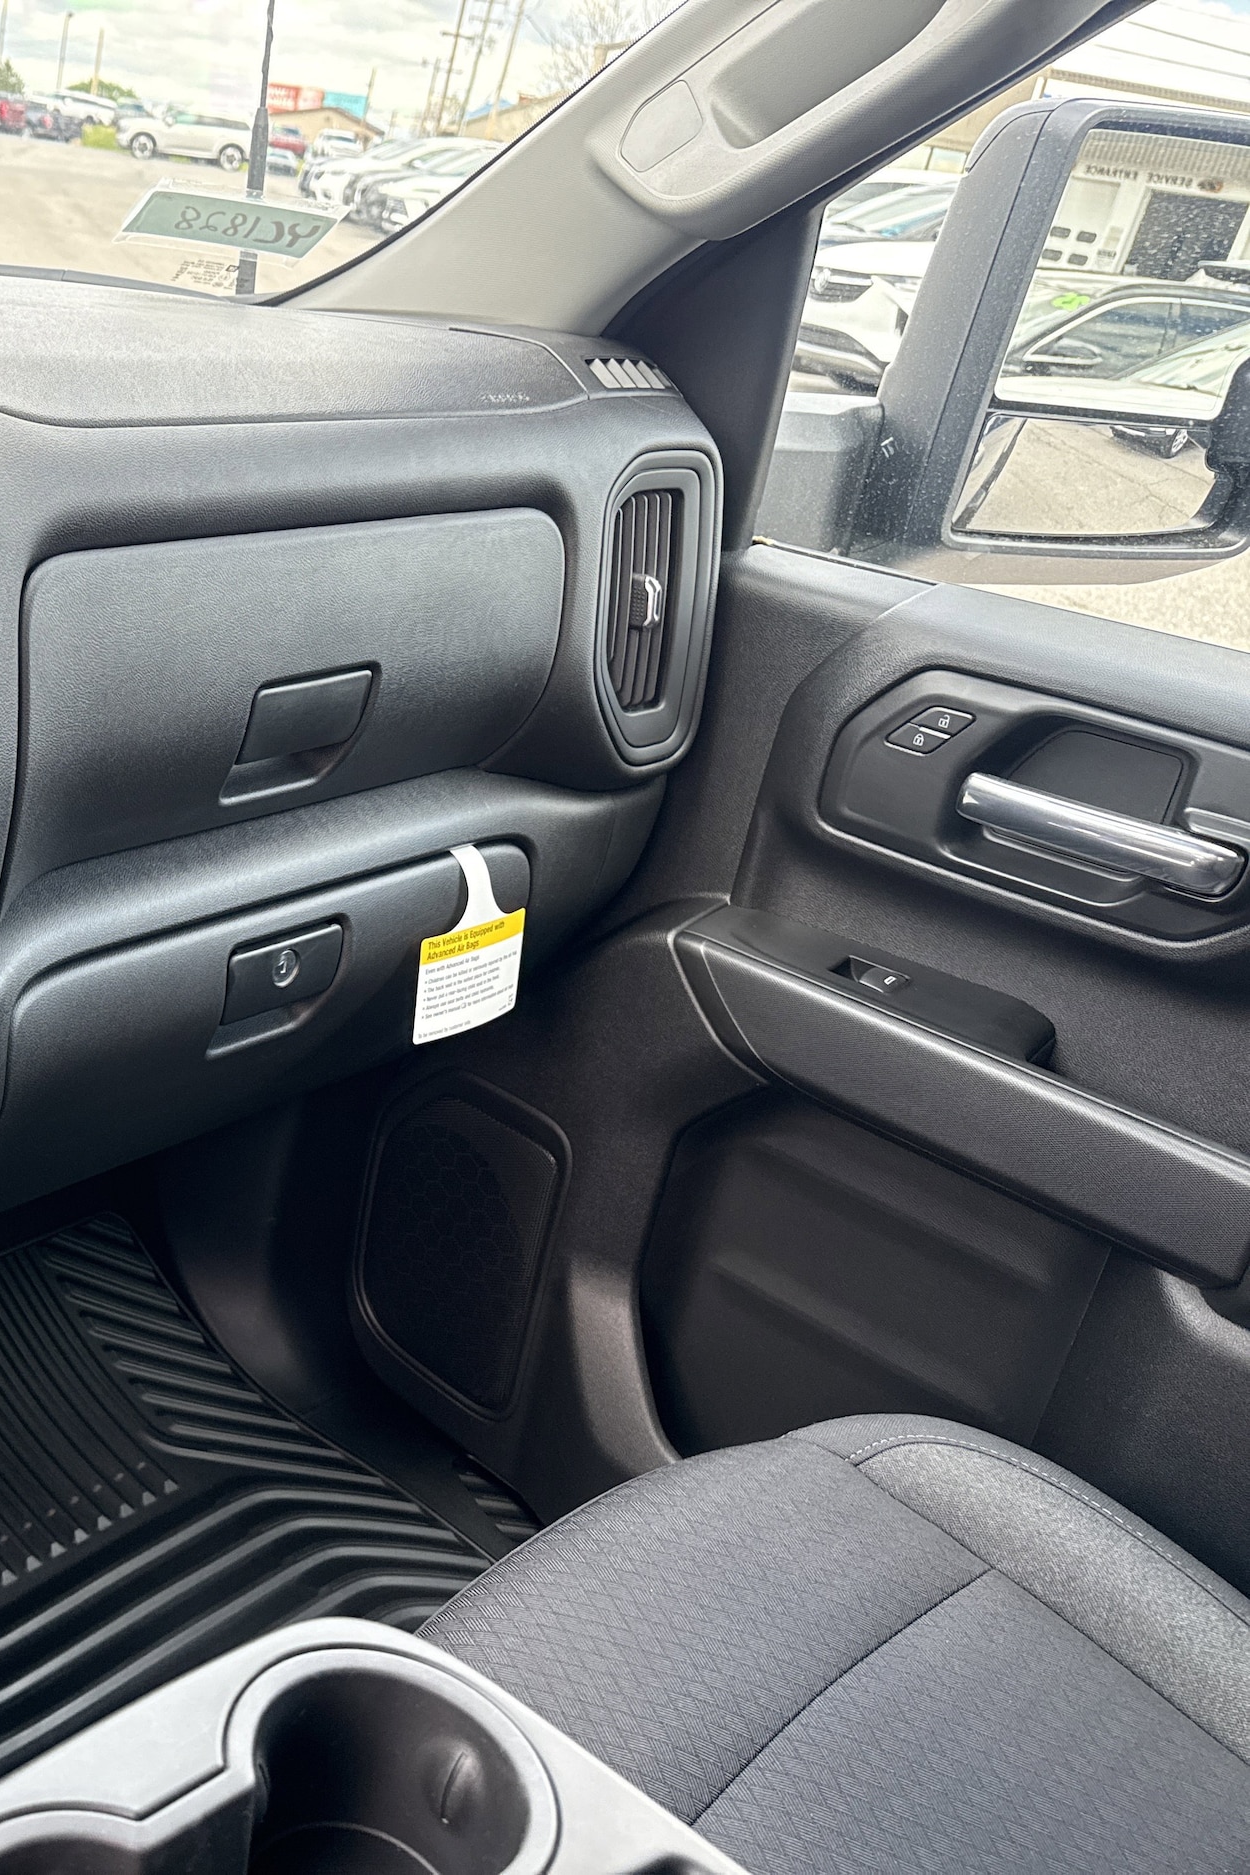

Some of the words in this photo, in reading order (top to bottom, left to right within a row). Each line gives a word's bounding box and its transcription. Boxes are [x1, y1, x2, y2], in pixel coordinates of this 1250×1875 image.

[428, 941, 441, 951] This
[442, 936, 463, 947] Vehicle
[464, 932, 469, 940] is
[470, 924, 494, 939] Equipped
[495, 921, 505, 930] with
[427, 947, 456, 961] Advanced
[457, 943, 465, 952] Air
[466, 940, 480, 951] Bags
